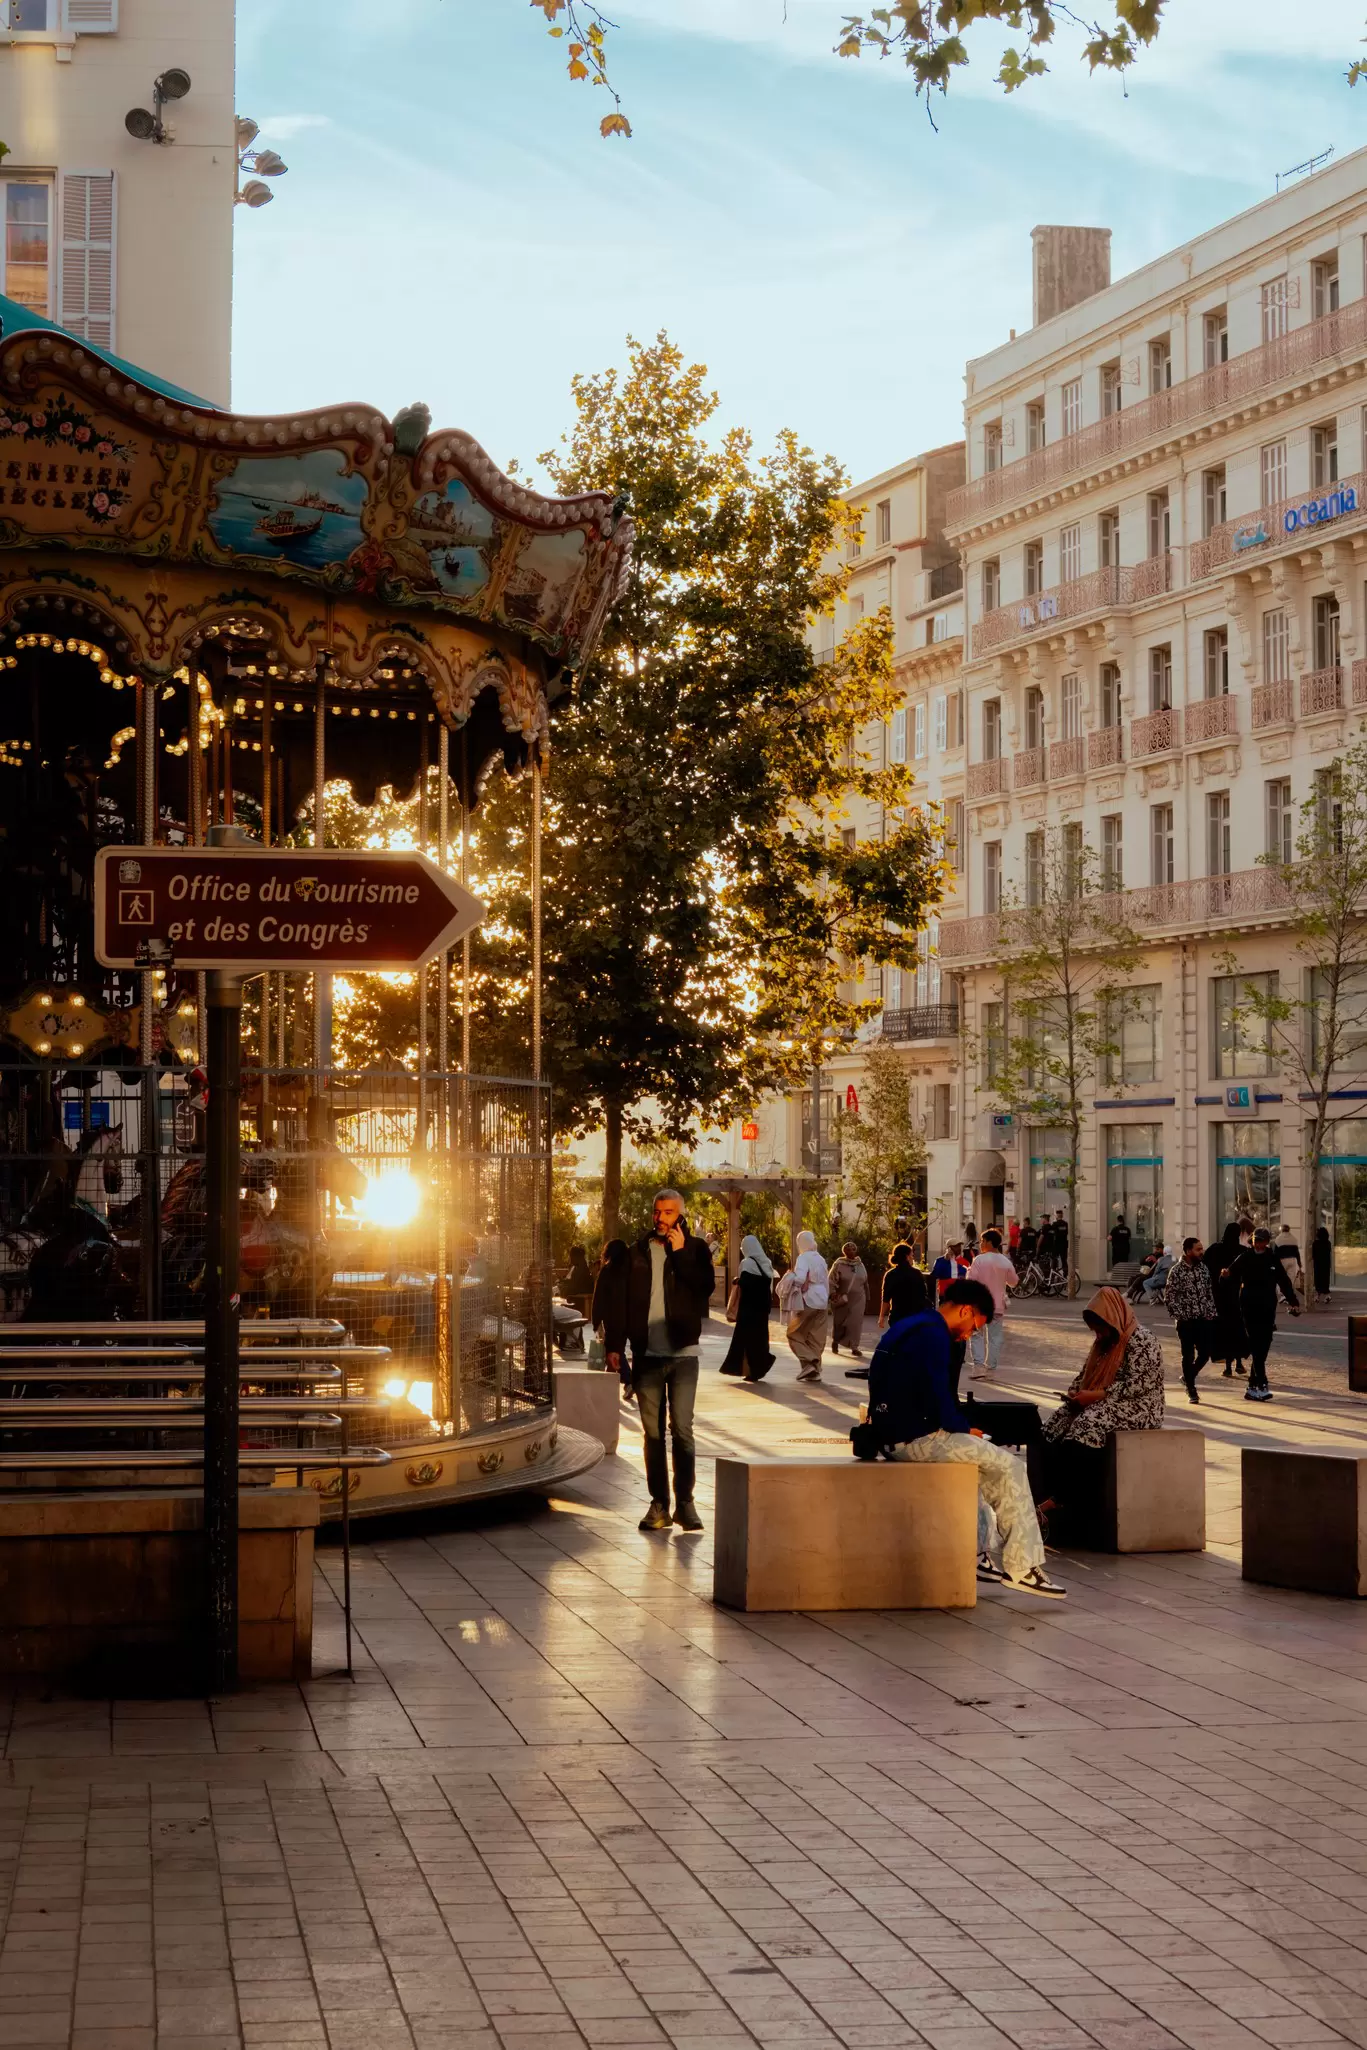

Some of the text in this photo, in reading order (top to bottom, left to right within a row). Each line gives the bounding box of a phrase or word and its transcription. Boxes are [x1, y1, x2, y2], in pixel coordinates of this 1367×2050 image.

[0, 460, 131, 487] ENITIEN
[1285, 483, 1356, 532] oceania
[168, 875, 420, 904] Office du Tourisme
[168, 916, 369, 950] et des Congrès
[1228, 1090, 1247, 1104] CIC
